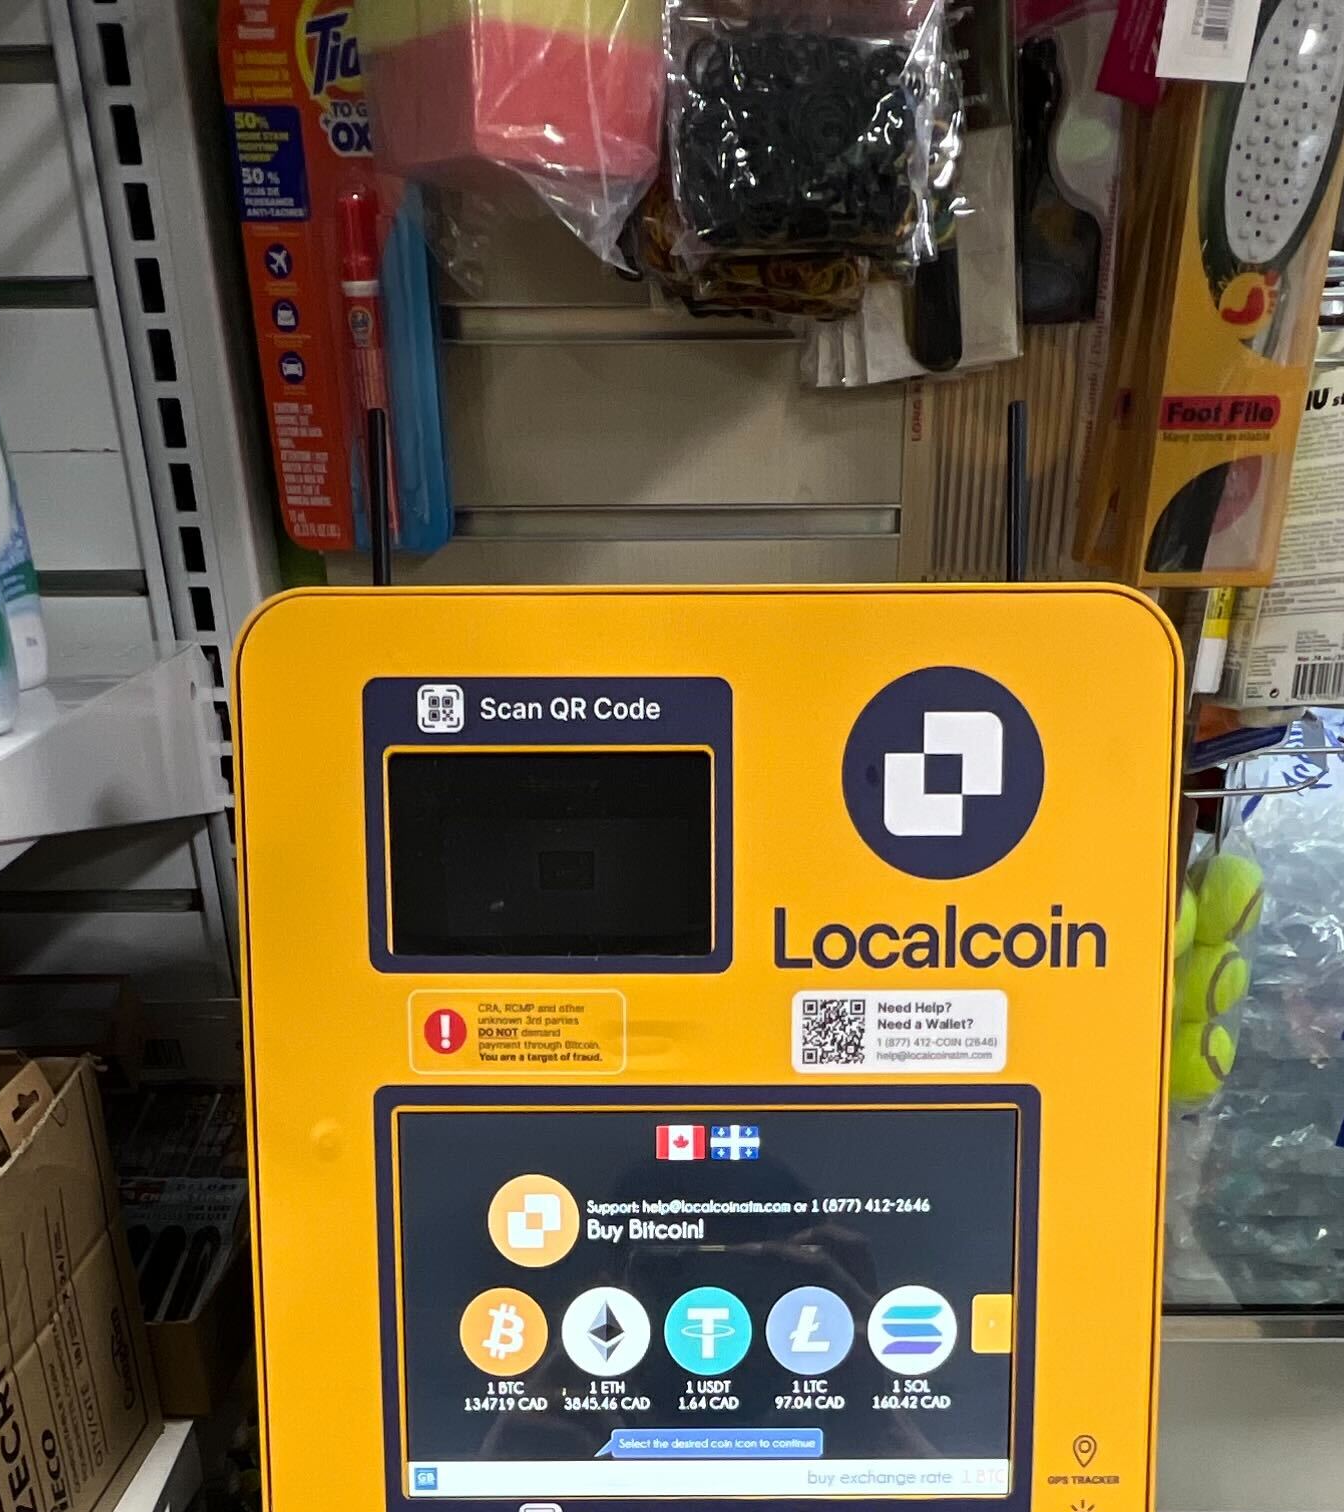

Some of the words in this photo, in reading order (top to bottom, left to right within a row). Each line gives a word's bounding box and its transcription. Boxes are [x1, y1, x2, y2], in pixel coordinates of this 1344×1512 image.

[1166, 402, 1223, 425] Foot
[1228, 402, 1275, 425] File
[480, 697, 543, 720] Scan
[550, 697, 588, 722] QR
[593, 697, 662, 720] Code
[773, 904, 1108, 970] Localcoin
[478, 1004, 502, 1014] CRA,
[505, 1003, 535, 1013] RCMP
[537, 1004, 556, 1013] and
[558, 1003, 585, 1013] other
[877, 1002, 912, 1014] Need
[915, 1002, 953, 1016] Help?
[478, 1016, 522, 1025] unknown
[526, 1016, 542, 1025] 3rd
[545, 1016, 580, 1027] parties
[877, 1018, 912, 1030] Need
[925, 1018, 975, 1030] Wallet?
[478, 1028, 494, 1038] DO
[496, 1028, 519, 1038] NOT
[521, 1028, 561, 1038] demand
[479, 1041, 522, 1052] payment
[524, 1040, 562, 1052] through
[885, 1037, 911, 1048] (877)
[913, 1037, 962, 1048] 412-COIN
[479, 1052, 499, 1062] You
[500, 1054, 516, 1062] are
[527, 1053, 559, 1064] target
[573, 1052, 603, 1062] fraud.
[586, 1200, 640, 1217] Support:
[642, 1200, 791, 1217] help@localcoinatm.com
[793, 1203, 807, 1214] or
[823, 1198, 862, 1215] (877)
[865, 1199, 931, 1214] 412-2646
[586, 1219, 623, 1244] Buy
[628, 1219, 705, 1240] Bitcoin!
[498, 1381, 525, 1395] BTC
[600, 1381, 626, 1395] ETH
[697, 1380, 732, 1394] USDT
[803, 1379, 828, 1393] LTC
[903, 1379, 931, 1393] SOL
[464, 1396, 515, 1411] 134719
[518, 1396, 548, 1411] CAD
[564, 1396, 617, 1411] 3845.46
[621, 1396, 651, 1411] CAD
[677, 1396, 706, 1410] 1.64
[709, 1396, 740, 1410] CAD
[774, 1396, 812, 1410] 97.04
[815, 1395, 845, 1410] CAD
[872, 1395, 917, 1410] 160.42
[920, 1395, 951, 1410] CAD
[618, 1438, 651, 1450] Select
[653, 1438, 669, 1450] the
[671, 1438, 709, 1450] desired
[710, 1438, 733, 1450] coin
[735, 1438, 757, 1449] icon
[759, 1439, 770, 1449] to
[772, 1438, 816, 1449] continue
[807, 1470, 835, 1487] buy
[839, 1470, 917, 1487] exchange
[921, 1472, 953, 1485] rate
[1047, 1475, 1069, 1485] GPS
[1071, 1475, 1120, 1485] TRACKER
